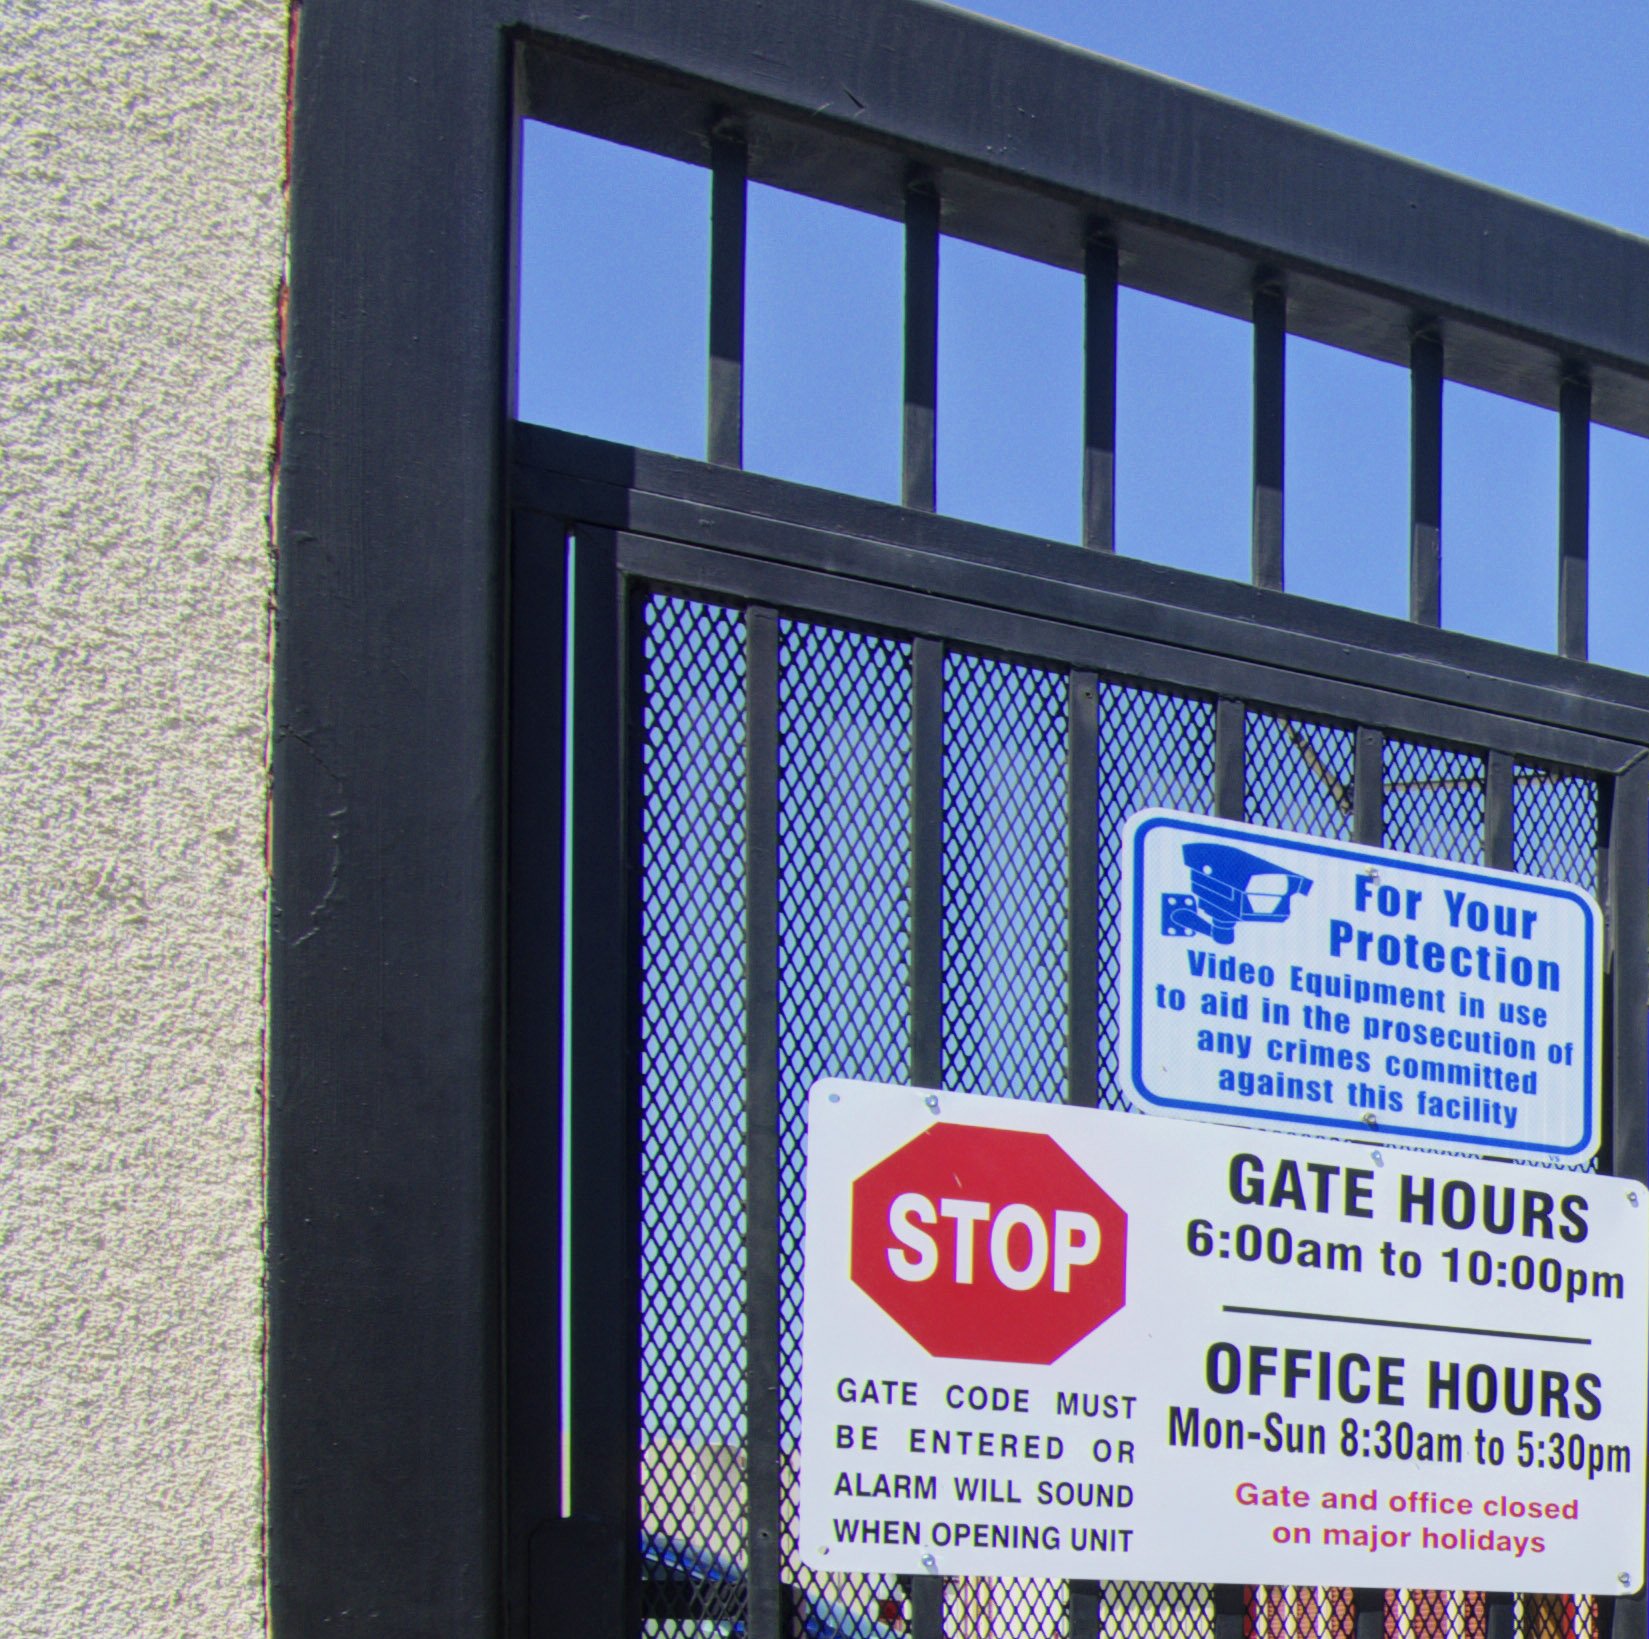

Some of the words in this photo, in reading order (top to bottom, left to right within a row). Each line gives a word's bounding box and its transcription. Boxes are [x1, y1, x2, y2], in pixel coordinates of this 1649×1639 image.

[1356, 874, 1422, 920] For
[1444, 890, 1537, 939] Your
[1330, 919, 1559, 993] Protection
[1187, 950, 1274, 987] Video
[1291, 966, 1445, 1013] Equipment
[1460, 992, 1484, 1019] in
[1499, 1003, 1547, 1028] use
[1156, 984, 1185, 1010] to
[1201, 992, 1247, 1019] aid
[1262, 997, 1289, 1025] in
[1303, 1005, 1350, 1034] the
[1364, 1017, 1535, 1060] prosecution
[1548, 1042, 1573, 1066] of
[1198, 1030, 1251, 1059] any
[1267, 1039, 1370, 1072] crimes
[1386, 1056, 1536, 1094] committed
[1219, 1069, 1333, 1103] against
[1348, 1083, 1402, 1112] this
[1417, 1091, 1517, 1128] facility
[1229, 1153, 1374, 1218] GATE
[1400, 1174, 1588, 1243] HOURS
[888, 1193, 1099, 1292] STOP
[1187, 1219, 1361, 1272] 6:00am
[1379, 1242, 1421, 1278] to
[1442, 1248, 1623, 1303] 10:00pm
[837, 1378, 917, 1406] GATE
[945, 1385, 1029, 1412] CODE
[1056, 1392, 1136, 1419] MUST
[1205, 1342, 1404, 1406] OFFICE
[1428, 1361, 1601, 1420] HOURS
[836, 1425, 877, 1450] BE
[909, 1429, 1063, 1459] ENTERED
[1093, 1439, 1134, 1463] OR
[1169, 1406, 1325, 1454] Mon-Sun
[1340, 1418, 1462, 1462] 8:30am
[1474, 1429, 1504, 1465] to
[1517, 1430, 1630, 1480] 5:30pm
[834, 1472, 936, 1499] ALARM
[953, 1478, 1021, 1503] WILL
[1037, 1481, 1133, 1507] SOUND
[1234, 1483, 1310, 1507] Gate
[1320, 1490, 1377, 1510] and
[1388, 1492, 1472, 1514] office
[1482, 1496, 1578, 1519] closed
[833, 1519, 920, 1544] WHEN
[931, 1523, 1060, 1550] OPENING
[1071, 1528, 1133, 1552] UNIT
[1272, 1527, 1310, 1544] on
[1322, 1525, 1411, 1552] major
[1422, 1528, 1545, 1557] holidays
